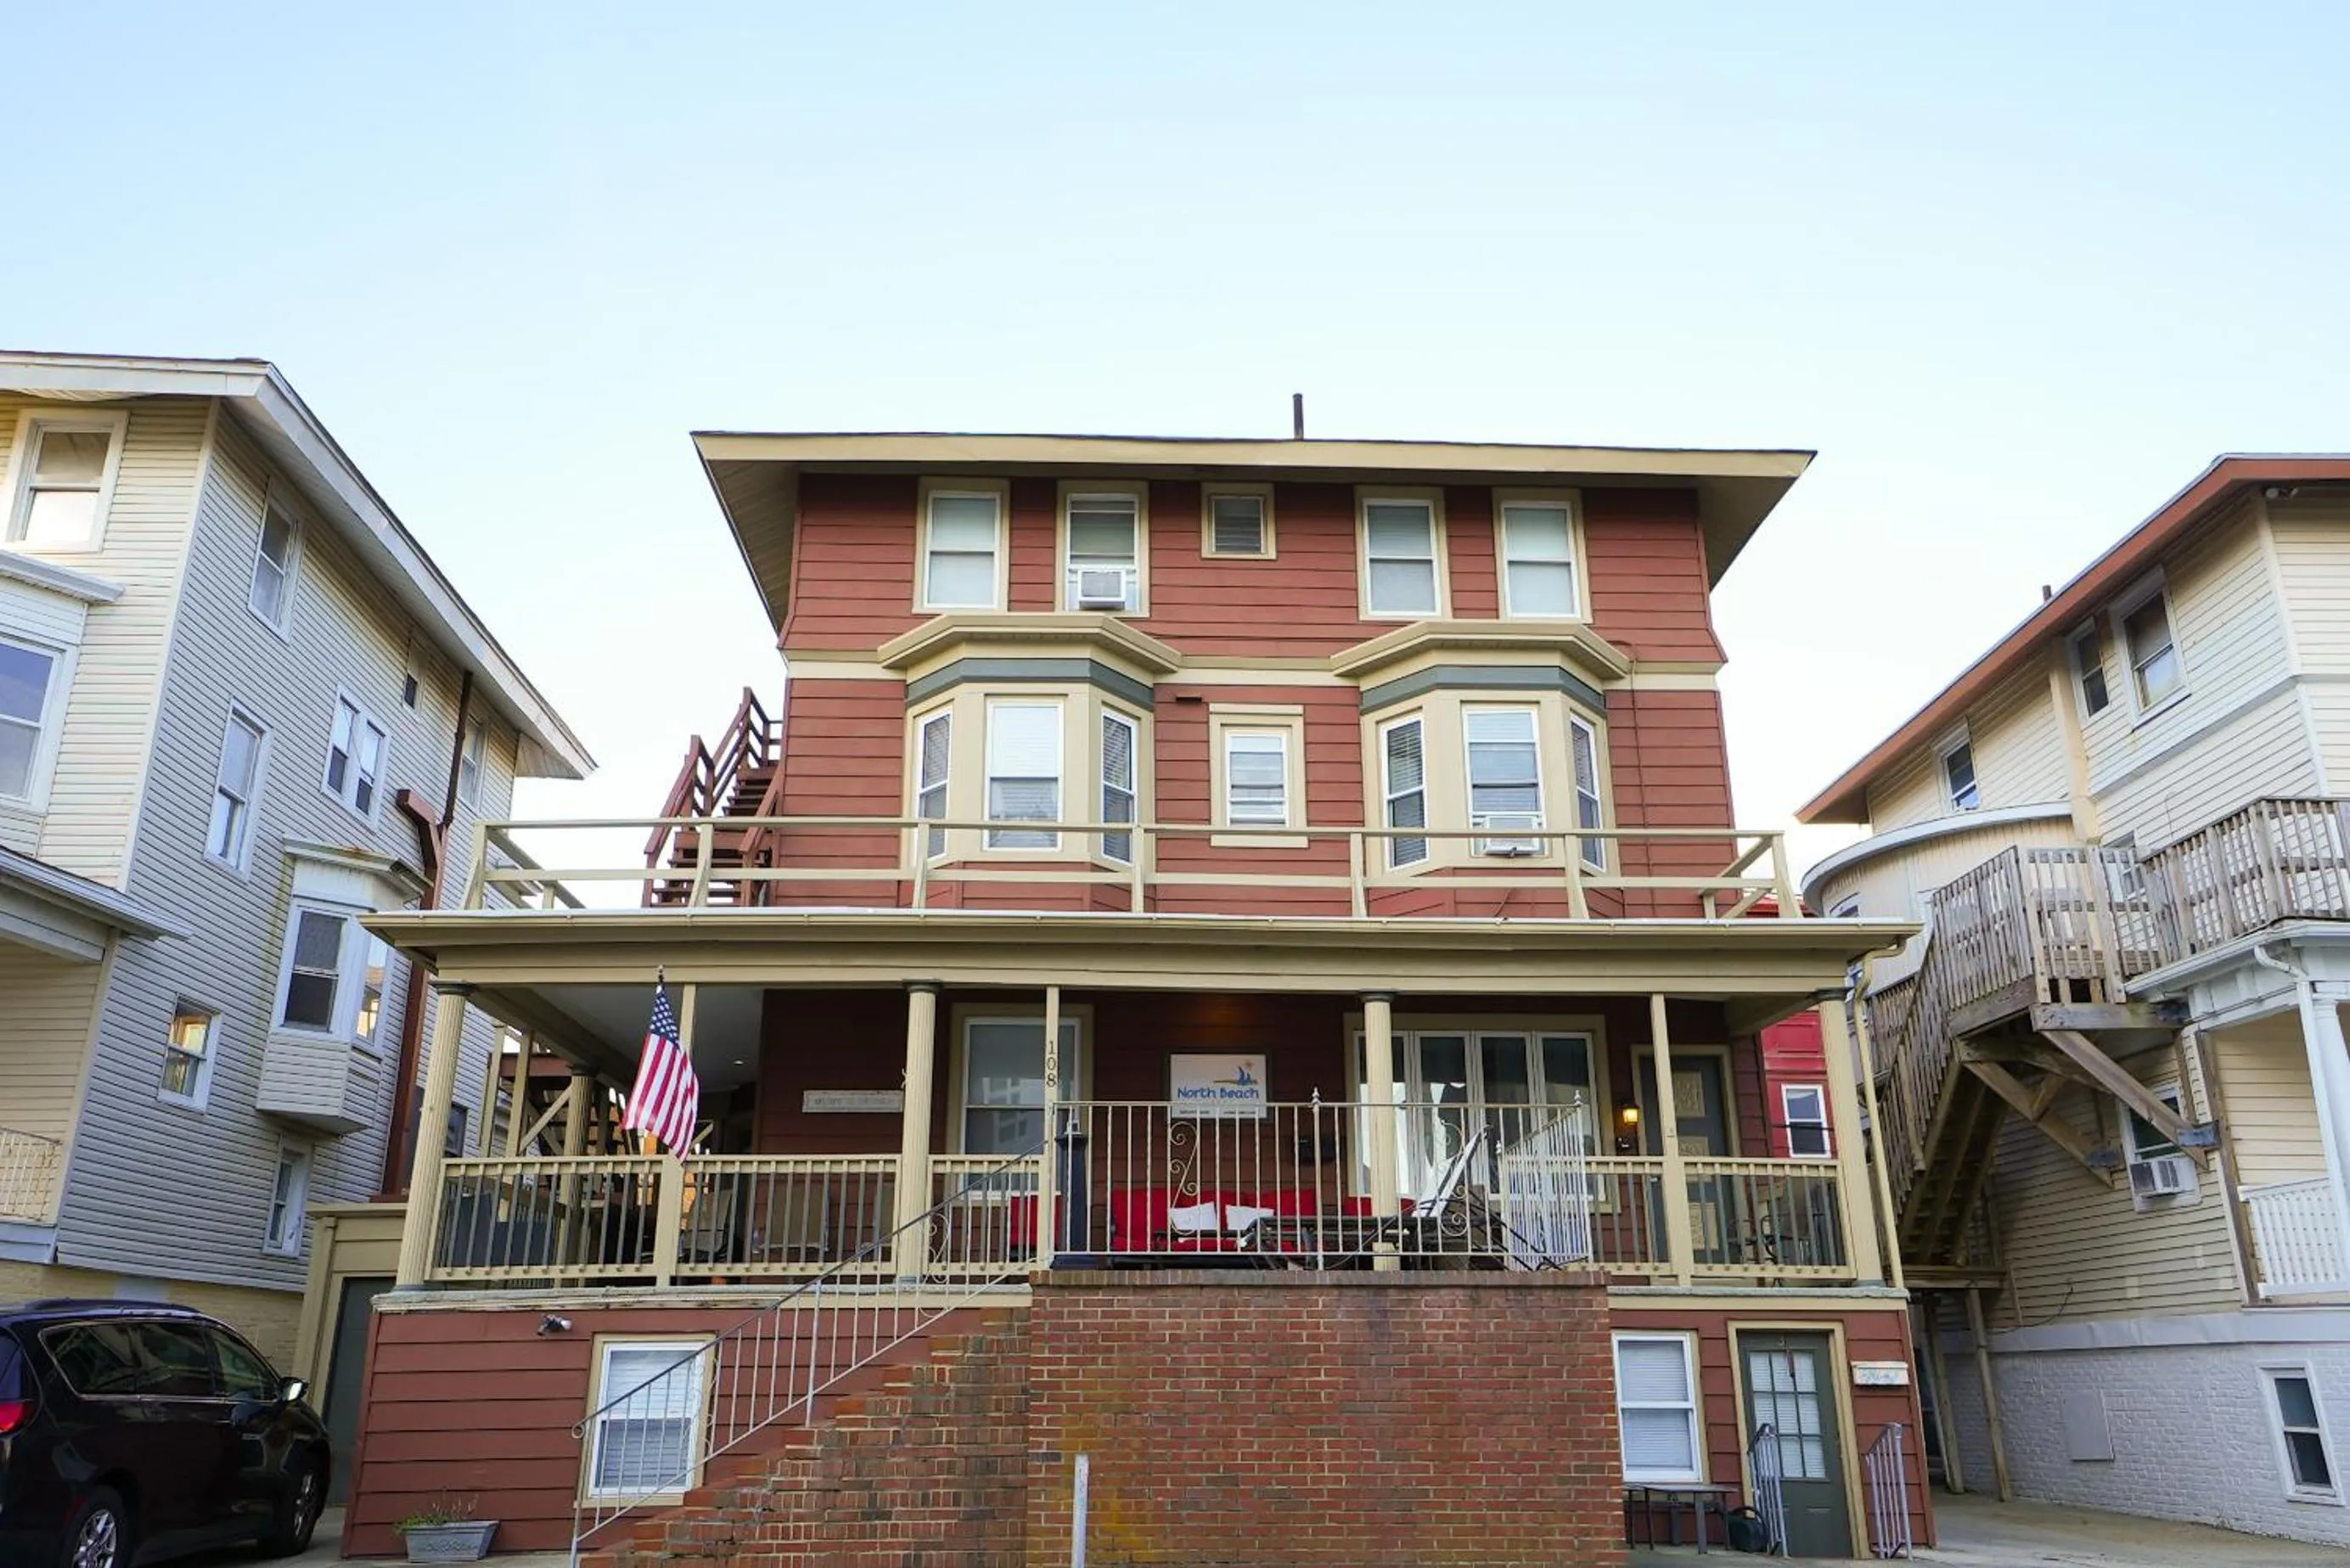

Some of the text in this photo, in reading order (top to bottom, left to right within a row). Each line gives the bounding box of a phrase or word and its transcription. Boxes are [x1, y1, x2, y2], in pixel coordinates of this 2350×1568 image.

[1046, 1040, 1056, 1087] 108
[1178, 1087, 1259, 1099] North Beach
